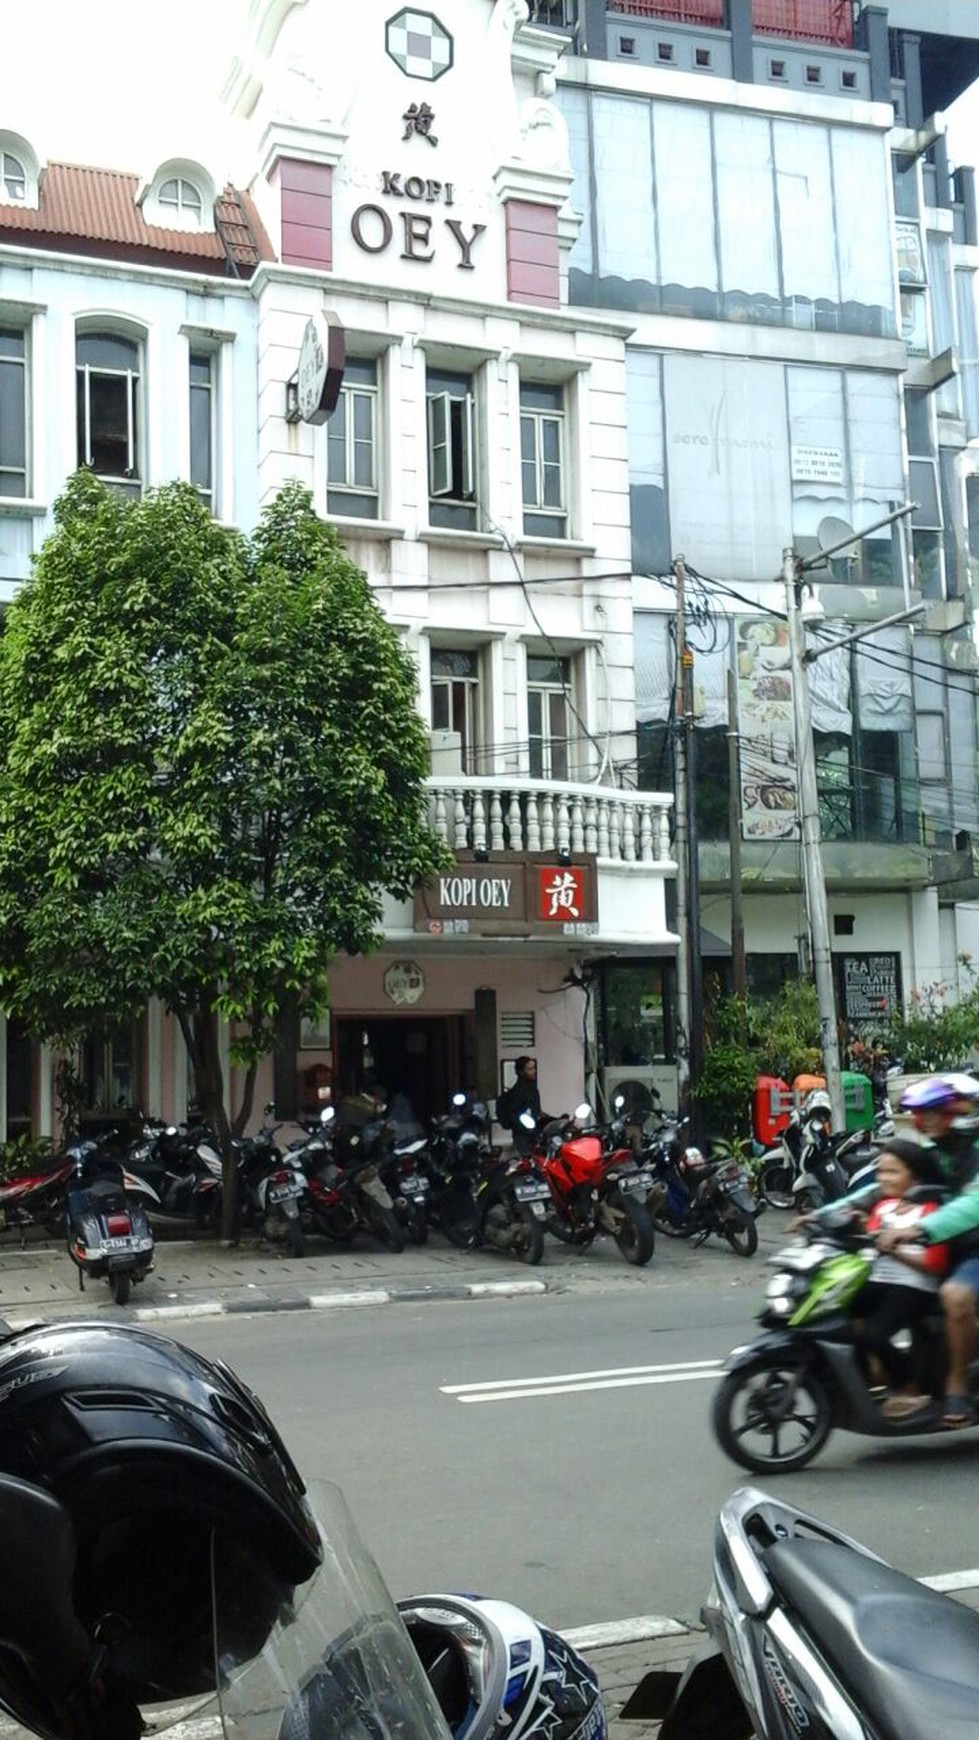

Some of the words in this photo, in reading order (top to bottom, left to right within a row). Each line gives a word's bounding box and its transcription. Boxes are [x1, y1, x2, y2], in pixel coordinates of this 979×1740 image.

[381, 171, 455, 206] KOPI
[351, 203, 488, 269] OEY
[439, 877, 477, 906] KOPI
[480, 878, 511, 907] OEY
[846, 960, 868, 973] TEA
[867, 976, 895, 984] LATTE
